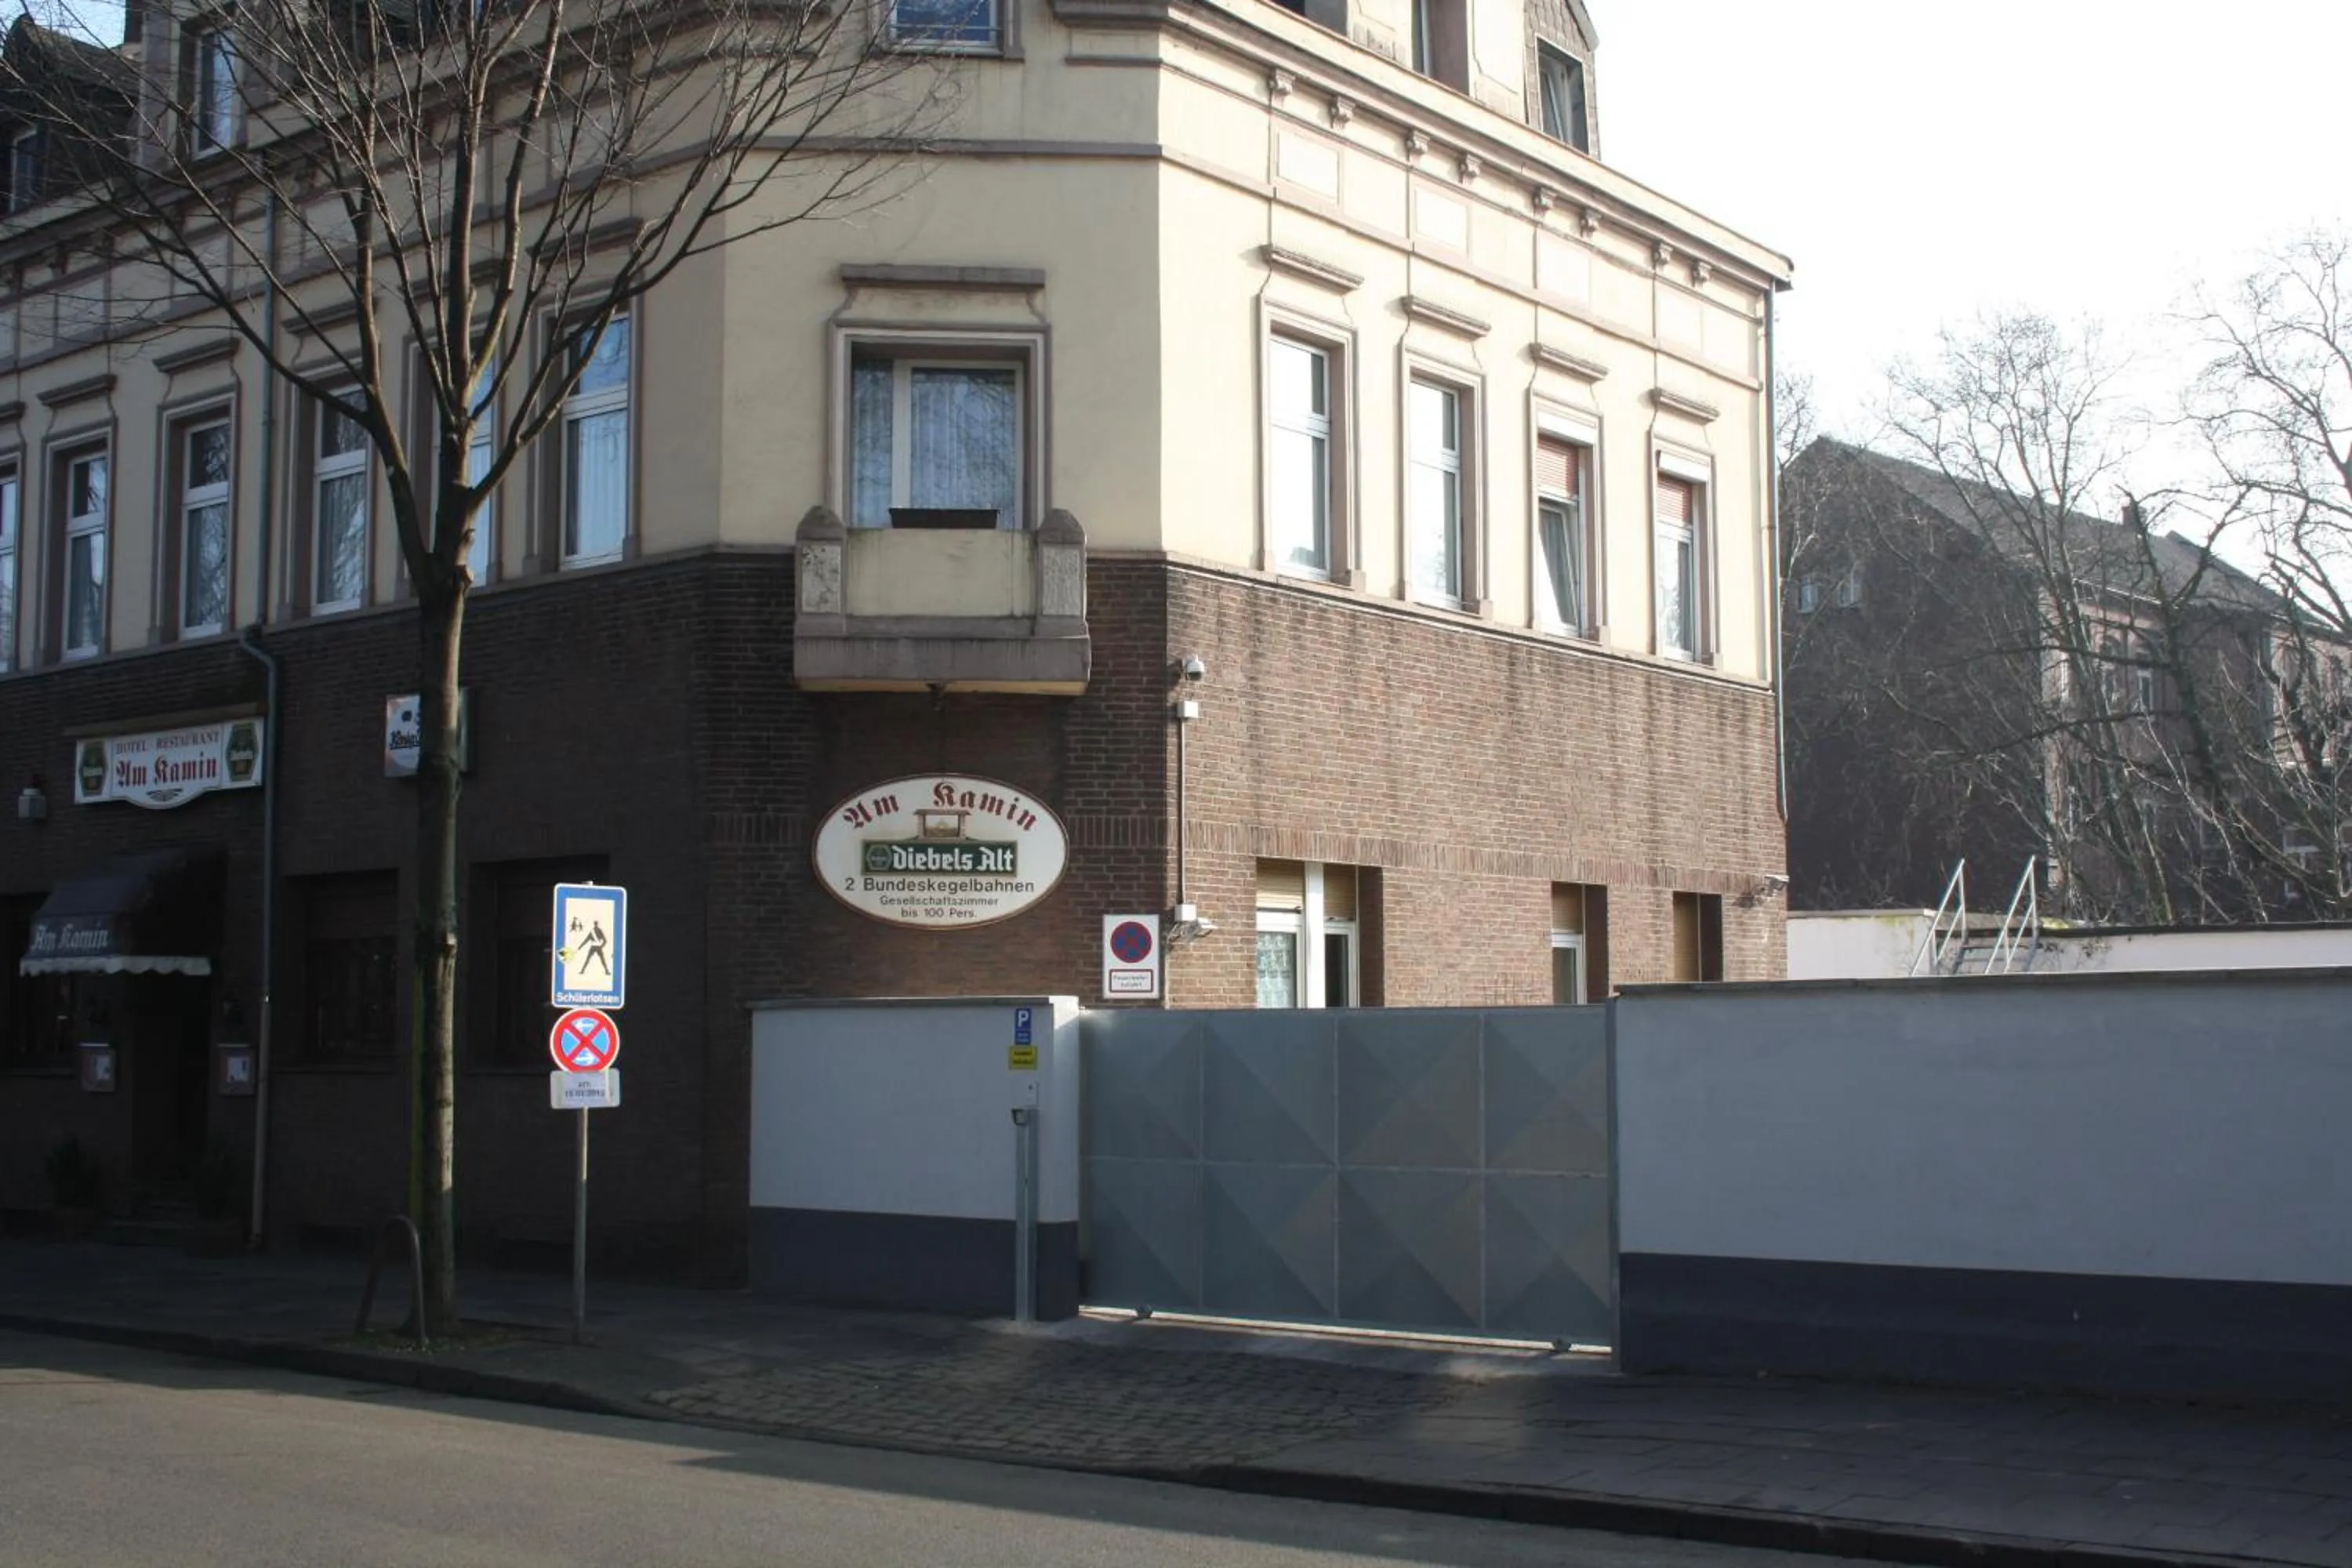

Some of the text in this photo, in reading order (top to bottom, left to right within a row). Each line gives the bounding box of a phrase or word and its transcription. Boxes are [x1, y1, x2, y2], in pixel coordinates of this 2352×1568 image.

[116, 731, 220, 754] HOTEL RESTAURANT
[116, 751, 217, 787] Am Kamin
[842, 782, 1036, 831] Am Kamin
[891, 844, 1014, 872] Diebels Alt
[844, 877, 1034, 894] 2 Bundeskegelbahnen
[880, 895, 999, 906] Gesellschaftszimmer
[901, 907, 977, 918] bis 100 Pers.
[1018, 1010, 1029, 1027] P
